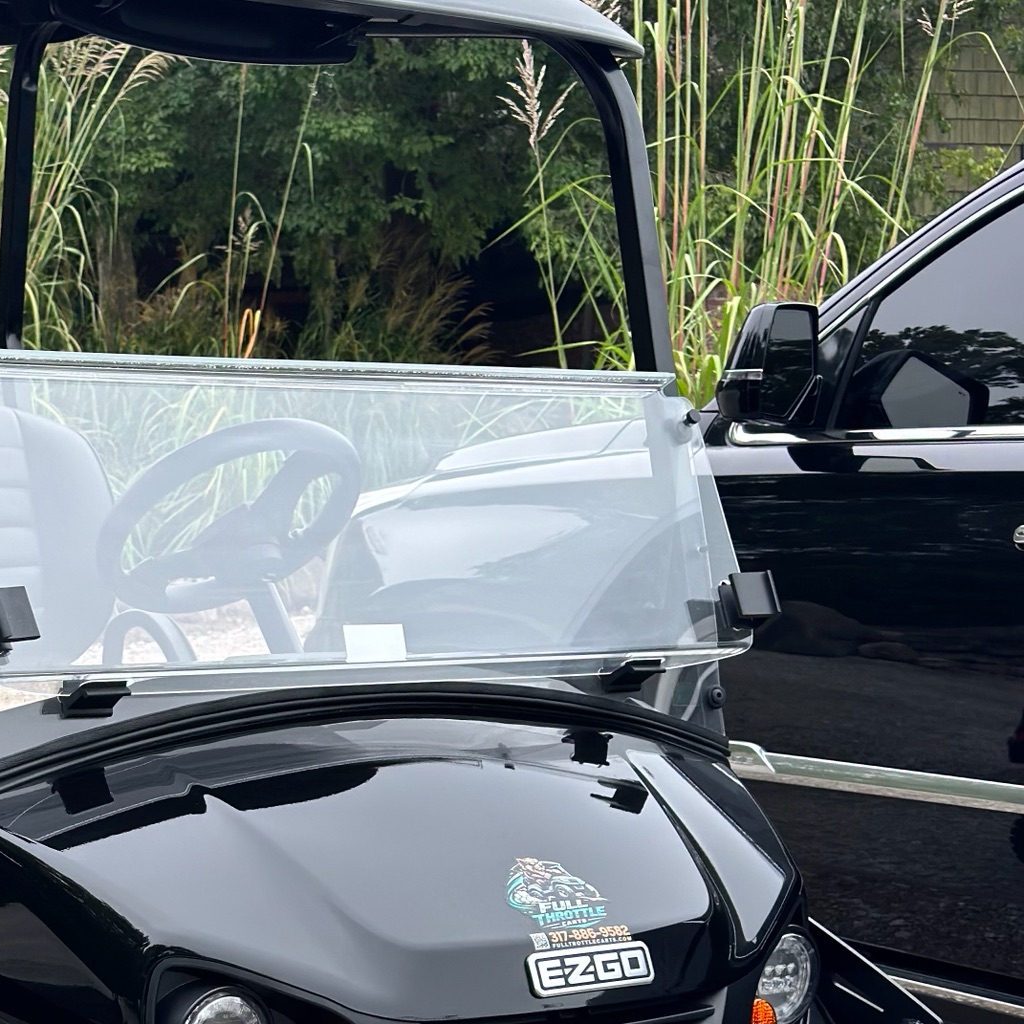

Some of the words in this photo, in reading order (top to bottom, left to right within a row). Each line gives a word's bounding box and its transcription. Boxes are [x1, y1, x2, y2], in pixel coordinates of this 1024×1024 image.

[539, 899, 588, 913] FULL
[532, 905, 607, 926] THROTTLE
[549, 925, 630, 943] 317-886-9582
